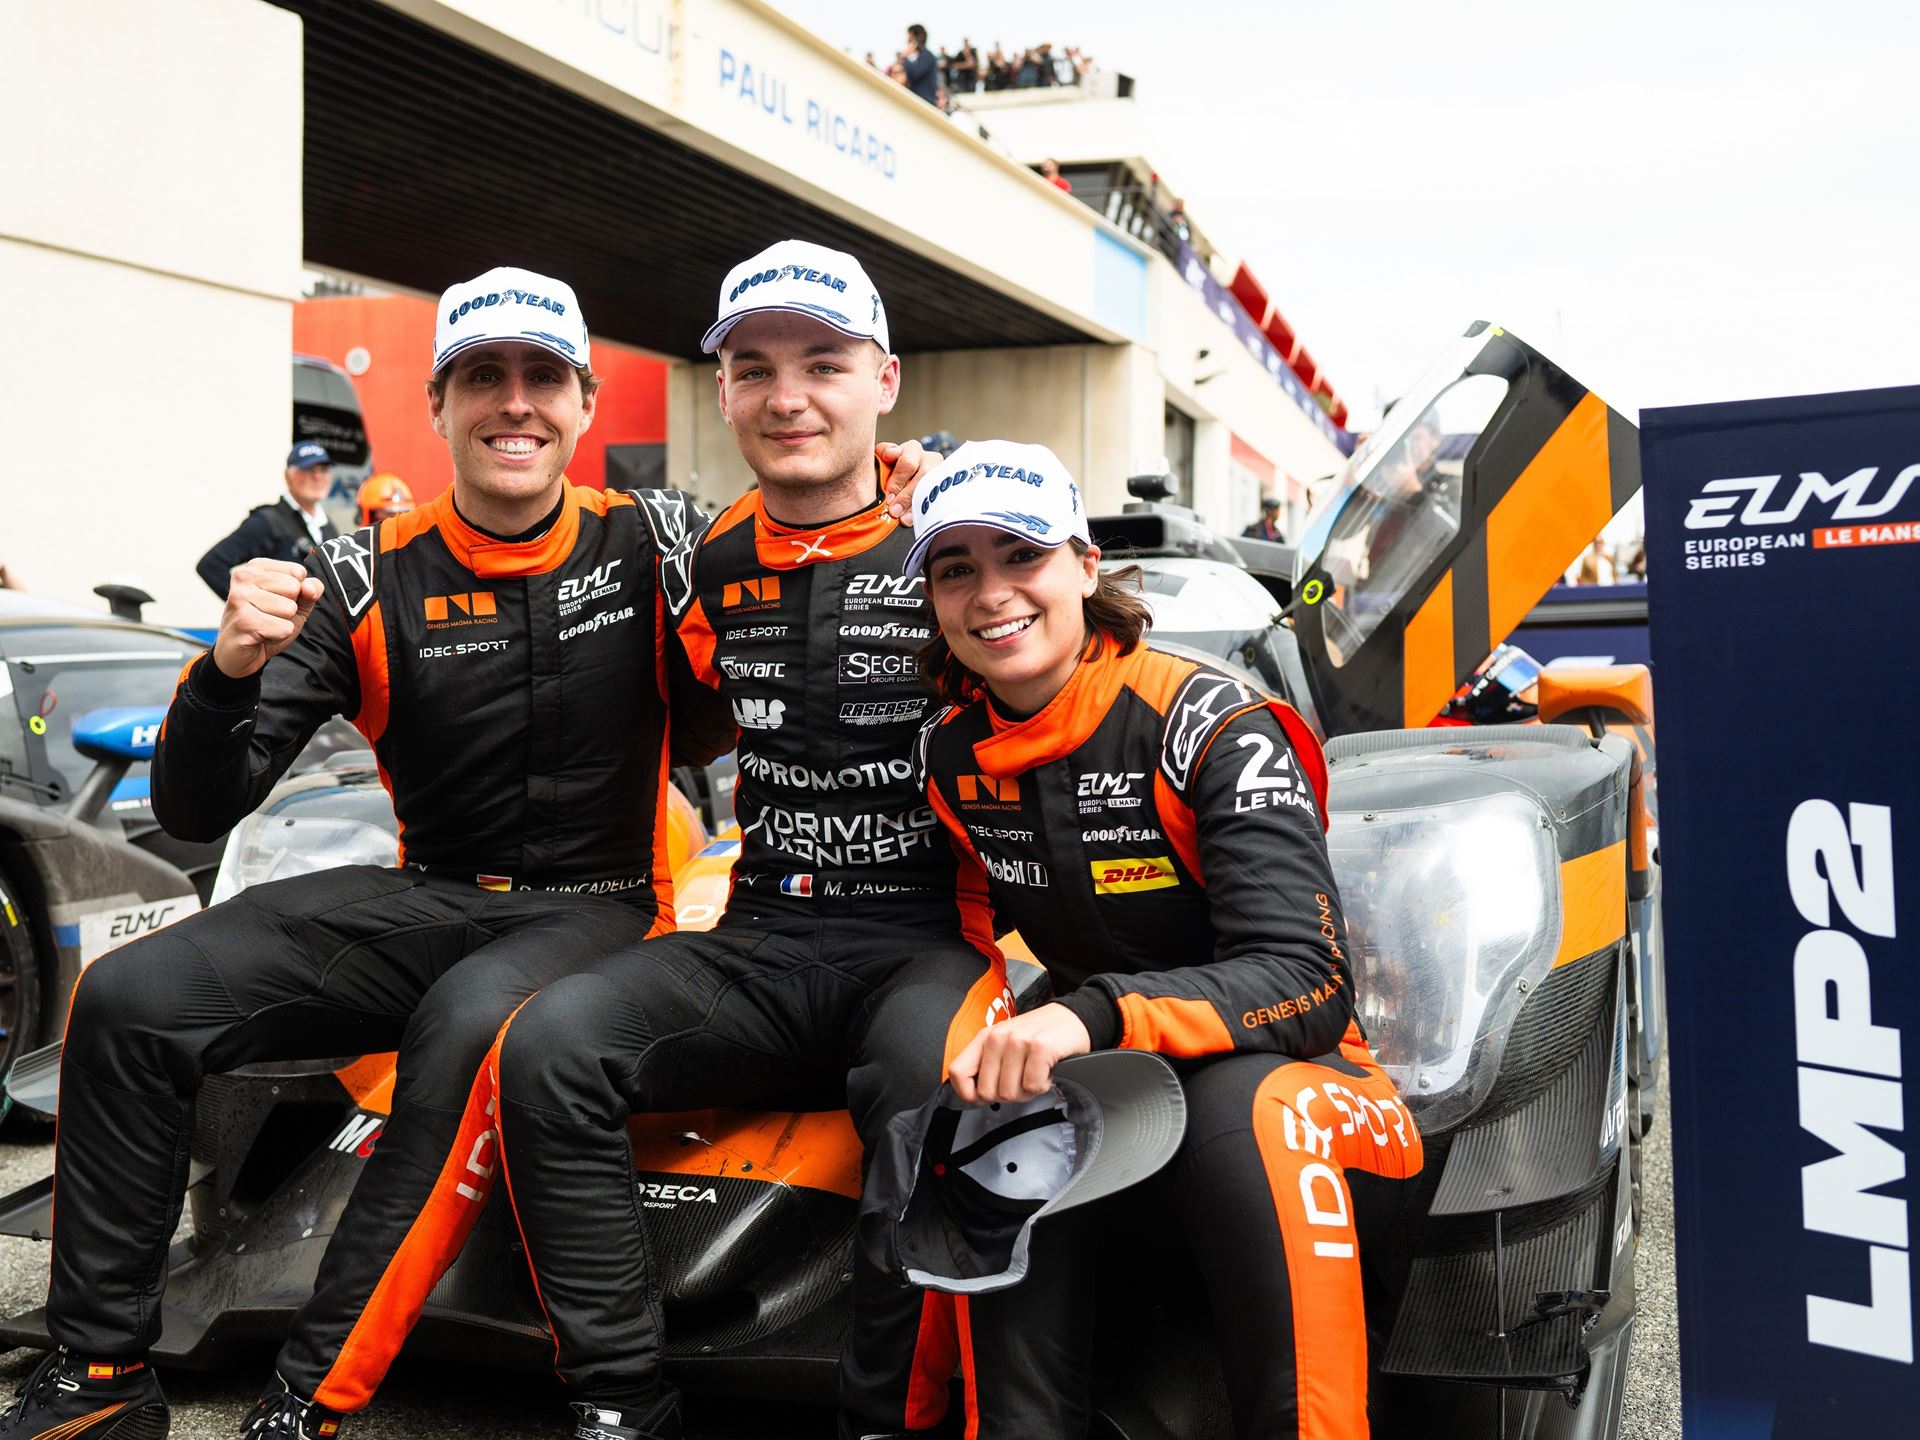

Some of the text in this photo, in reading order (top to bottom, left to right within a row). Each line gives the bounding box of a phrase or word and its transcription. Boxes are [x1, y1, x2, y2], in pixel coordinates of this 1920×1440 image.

[720, 48, 793, 125] PAUL
[807, 99, 896, 178] RICARD
[1684, 523, 1920, 554] EUROPEAN LE MANS
[1685, 551, 1766, 570] SERIES
[559, 594, 591, 611] EUROPEAN
[601, 584, 618, 595] MANS
[844, 597, 882, 605] EUROPEAN
[897, 598, 918, 607] MANS
[559, 604, 582, 617] SERIES
[426, 617, 498, 630] GENESIS MAGMA RACING
[1078, 806, 1102, 815] SERIES
[1235, 792, 1267, 813] LE
[774, 805, 938, 844] DRIVING
[979, 851, 1026, 885] Mobil
[1102, 865, 1164, 884] DHL
[824, 880, 846, 896] M.
[1242, 994, 1312, 1030] GENESIS
[1786, 799, 1914, 1365] LMP2
